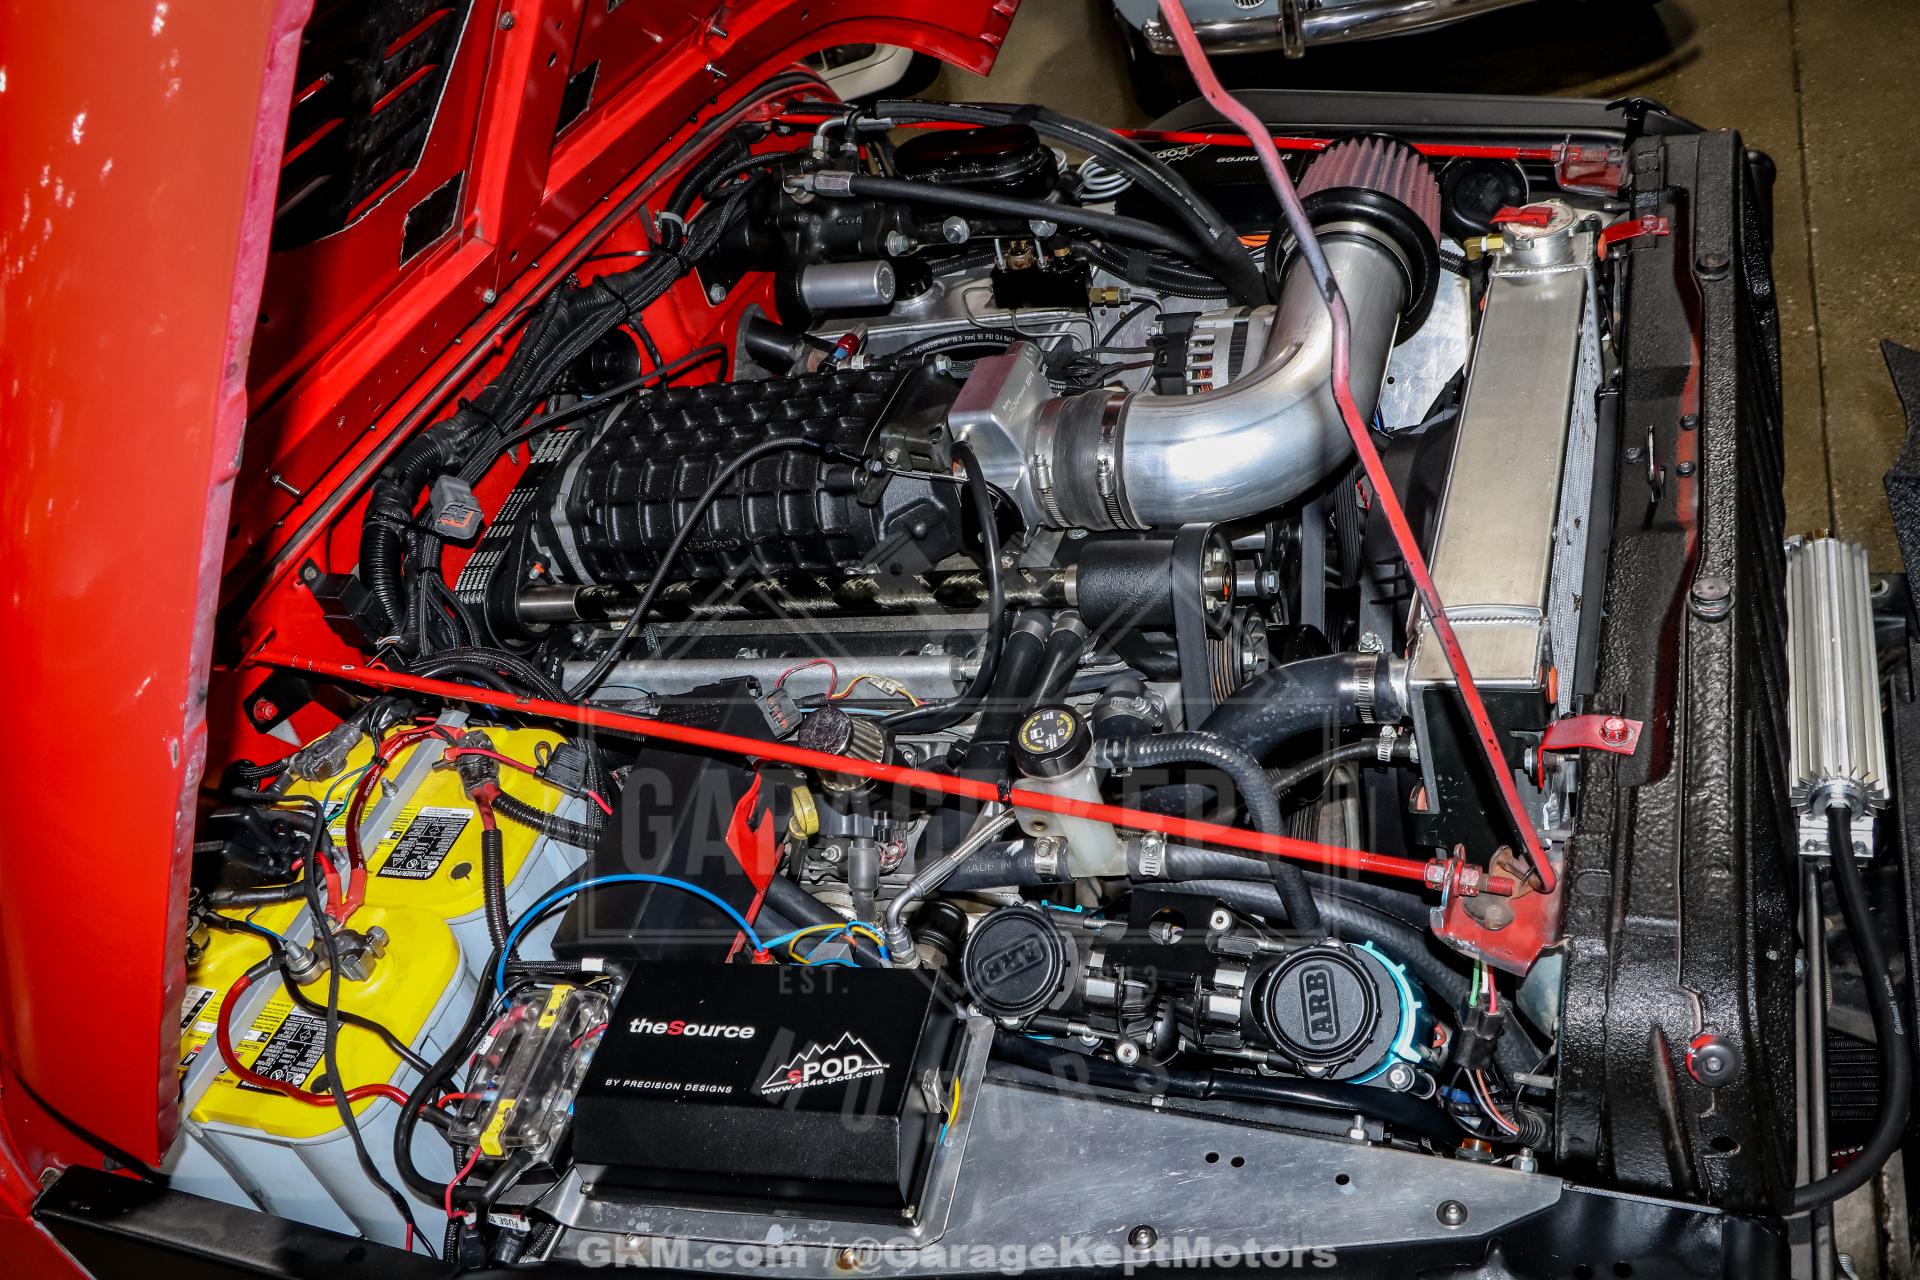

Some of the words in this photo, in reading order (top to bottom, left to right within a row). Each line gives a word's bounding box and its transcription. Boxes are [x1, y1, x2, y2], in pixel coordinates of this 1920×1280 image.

[1306, 971, 1335, 1035] ARB
[629, 1017, 755, 1039] theSource
[605, 1078, 620, 1087] BY
[623, 1079, 681, 1091] PRECISION
[684, 1083, 732, 1094] DESIGNS
[761, 1067, 885, 1095] www.4x4s-pod.com
